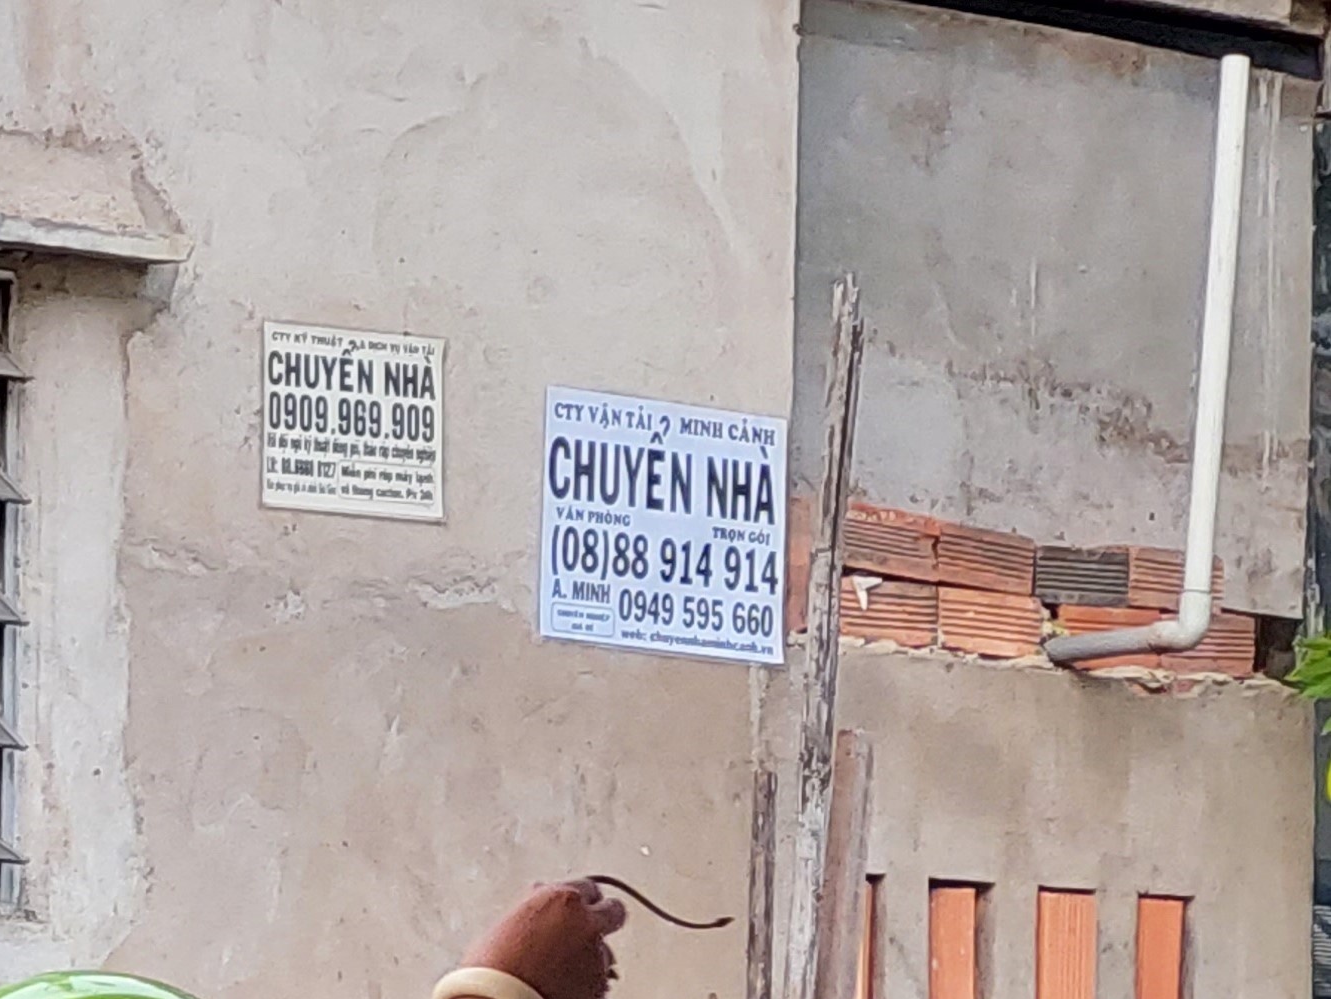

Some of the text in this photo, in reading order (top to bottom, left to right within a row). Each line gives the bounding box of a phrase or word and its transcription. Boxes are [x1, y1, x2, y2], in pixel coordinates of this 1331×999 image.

[269, 340, 436, 401] CHUYỂN NHÀ
[269, 391, 436, 443] 0909.969.909
[554, 402, 776, 446] CTY VẬN TẢI MINH CẢNH
[549, 415, 776, 526] CHUYỂN NHÀ
[551, 525, 778, 596] (08)88 914 914
[572, 580, 611, 604] MINH
[619, 588, 675, 626] 0949
[682, 595, 724, 633] 595
[732, 601, 774, 638] 660
